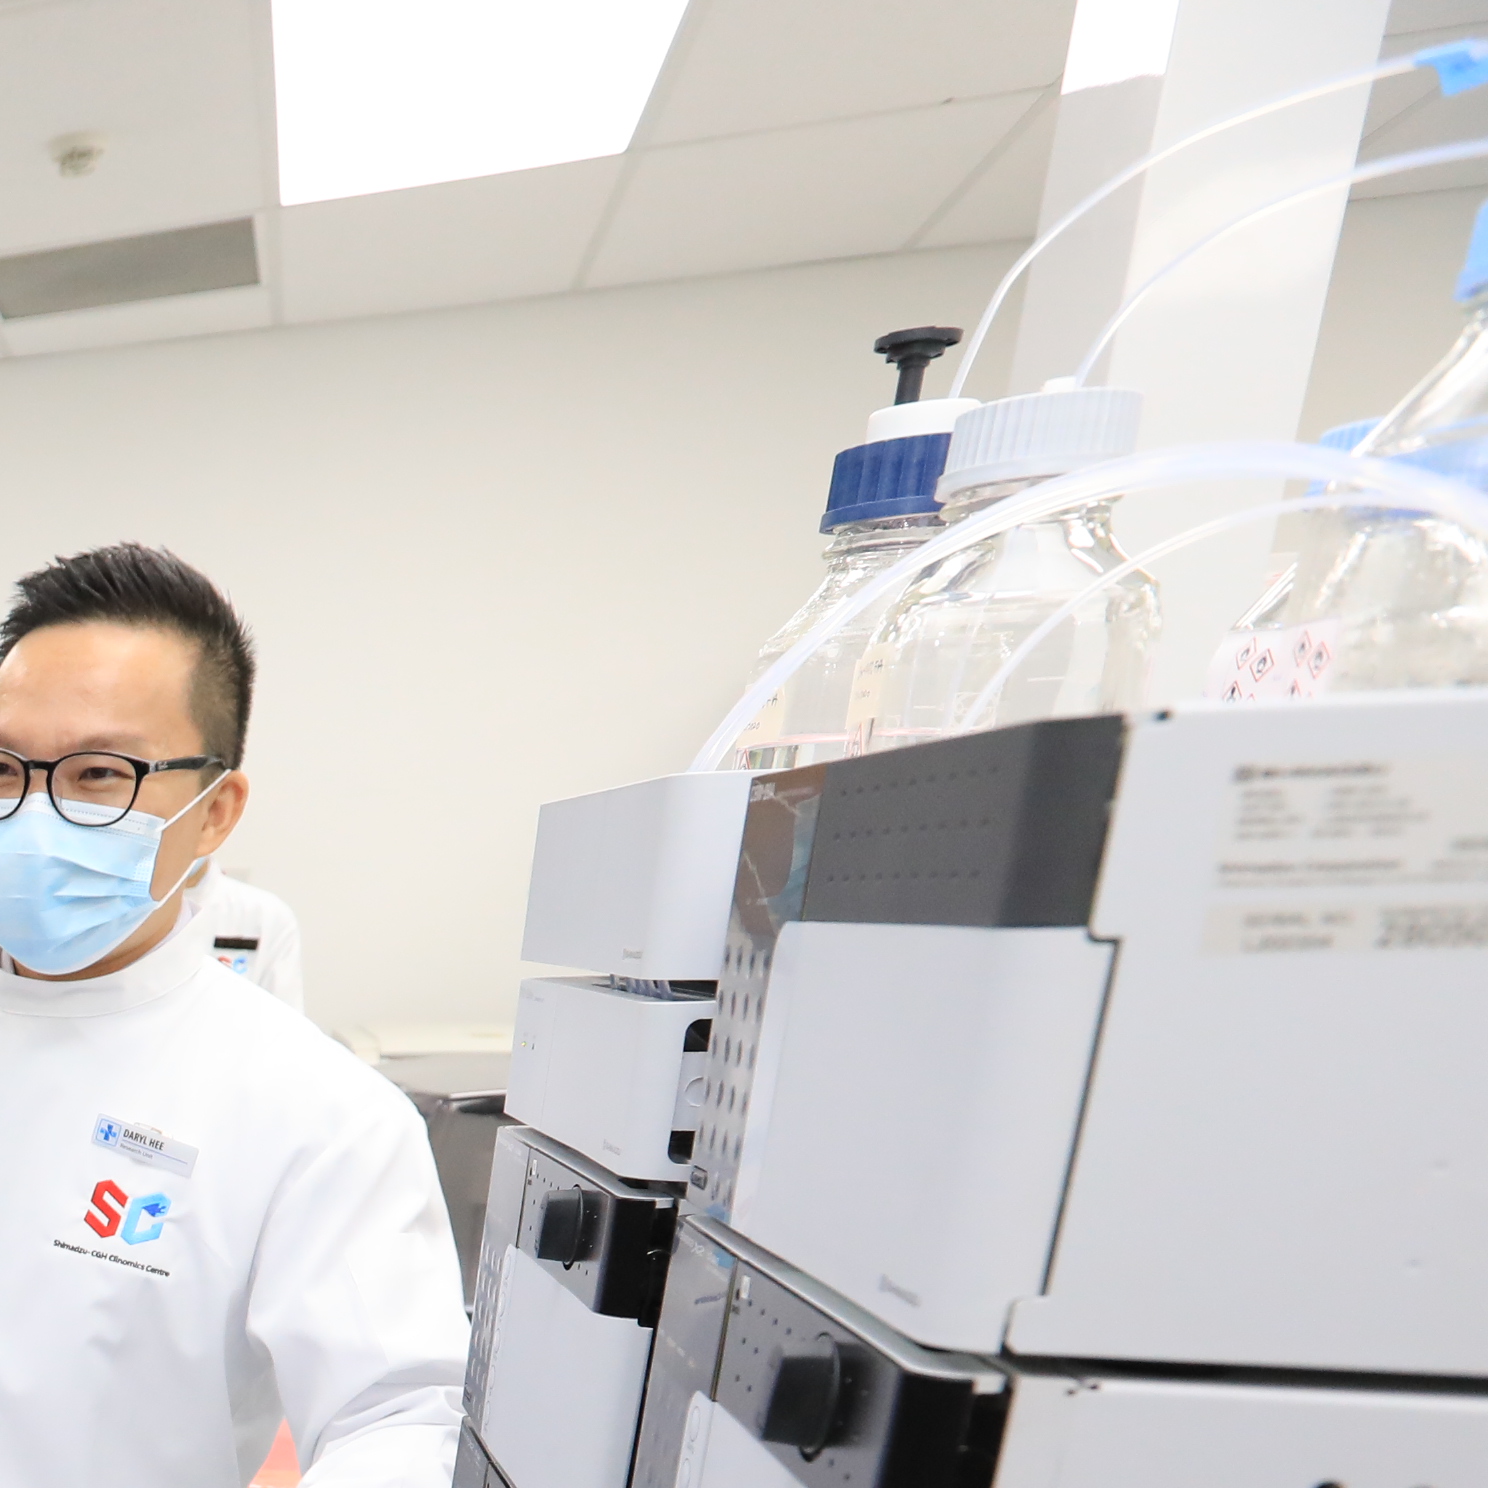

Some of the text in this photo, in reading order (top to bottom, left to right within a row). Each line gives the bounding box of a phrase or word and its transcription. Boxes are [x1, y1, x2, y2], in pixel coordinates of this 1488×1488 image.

[123, 1129, 165, 1151] DARYL HEE
[83, 1179, 172, 1246] SC
[108, 1254, 145, 1271] Clinomics
[145, 1264, 171, 1278] Centre
